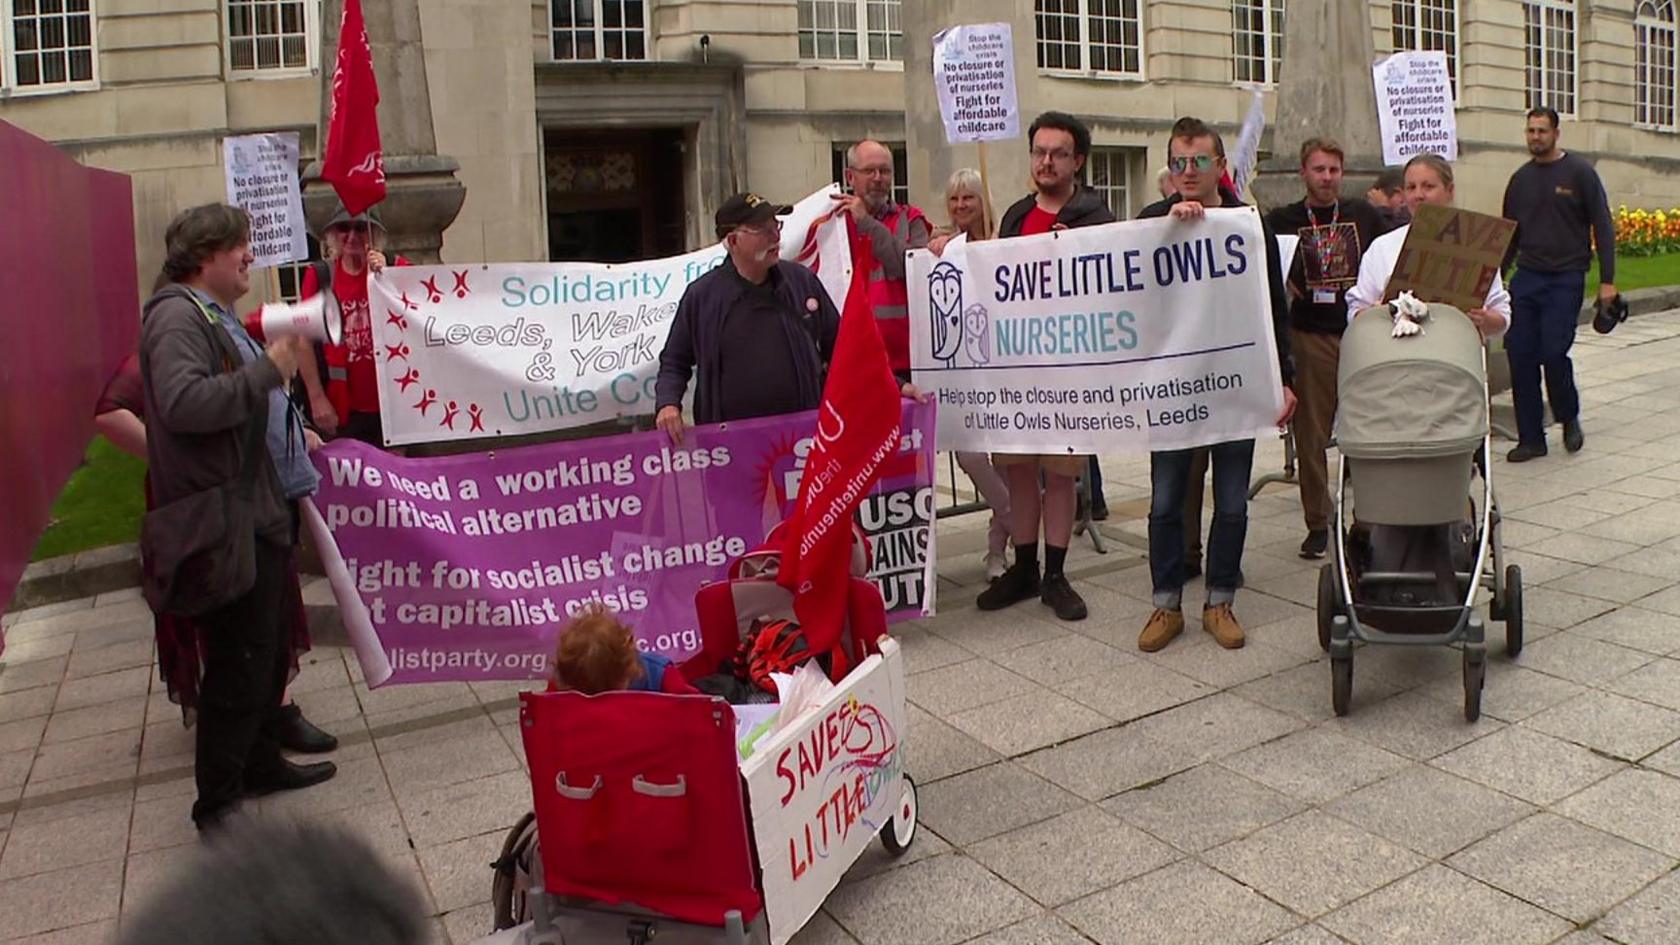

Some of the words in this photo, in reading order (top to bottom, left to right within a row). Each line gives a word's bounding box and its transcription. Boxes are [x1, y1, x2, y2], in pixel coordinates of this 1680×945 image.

[988, 33, 1001, 41] the
[943, 63, 957, 72] No
[958, 61, 993, 71] closure
[995, 60, 1004, 68] or
[946, 70, 1004, 84] privatisation
[949, 84, 959, 94] of
[960, 82, 1004, 92] nurseries
[1386, 86, 1399, 96] No
[1401, 85, 1433, 95] closure
[1435, 85, 1444, 93] or
[955, 95, 983, 109] Fight
[985, 94, 1001, 105] for
[1389, 95, 1445, 108] privatisation
[953, 108, 1008, 121] affordable
[1392, 107, 1402, 117] of
[1403, 105, 1445, 116] nurseries
[957, 121, 1006, 133] childcare
[1399, 119, 1425, 132] Fight
[1426, 118, 1442, 128] for
[1394, 131, 1449, 143] affordable
[1399, 143, 1448, 155] childcare
[233, 176, 247, 188] No
[248, 174, 279, 186] closure
[279, 173, 289, 182] or
[236, 185, 289, 202] privatisation
[250, 197, 288, 211] nurseries
[250, 213, 273, 230] ight
[274, 212, 286, 224] for
[248, 226, 292, 243] ffordable
[251, 242, 291, 257] hildcare
[994, 260, 1052, 303] SAVE
[1058, 250, 1144, 298] LITTLE
[1152, 234, 1247, 287] OWLS
[502, 272, 672, 307] Solidarity
[424, 315, 553, 351] Leeds,
[571, 300, 679, 343] Wake
[995, 310, 1139, 357] NURSERIES
[525, 352, 556, 383] &
[569, 333, 657, 377] York
[503, 386, 599, 422] Unite
[610, 371, 657, 405] Co
[938, 386, 967, 407] Help
[967, 386, 997, 408] stop
[1000, 386, 1024, 405] the
[1026, 386, 1079, 405] closure
[1082, 384, 1115, 403] and
[1119, 371, 1243, 407] privatisation
[964, 412, 976, 429] of
[976, 411, 1009, 430] Little
[1013, 411, 1051, 431] Owls
[1054, 410, 1142, 433] Nurseries,
[1147, 404, 1210, 428] Leeds
[328, 457, 383, 488] We
[387, 470, 451, 501] need
[458, 477, 480, 500] a
[496, 454, 636, 496] working
[643, 446, 731, 476] class
[327, 499, 457, 535] political
[462, 493, 642, 536] alternative
[859, 487, 933, 531] USC
[345, 557, 421, 593] ight
[432, 559, 481, 589] for
[487, 551, 615, 589] socialist
[623, 535, 746, 573] change
[878, 572, 922, 611] UT
[396, 596, 560, 630] capitalist
[565, 585, 648, 618] crisis
[391, 648, 548, 673] listparty.org
[635, 629, 703, 653] c.org.
